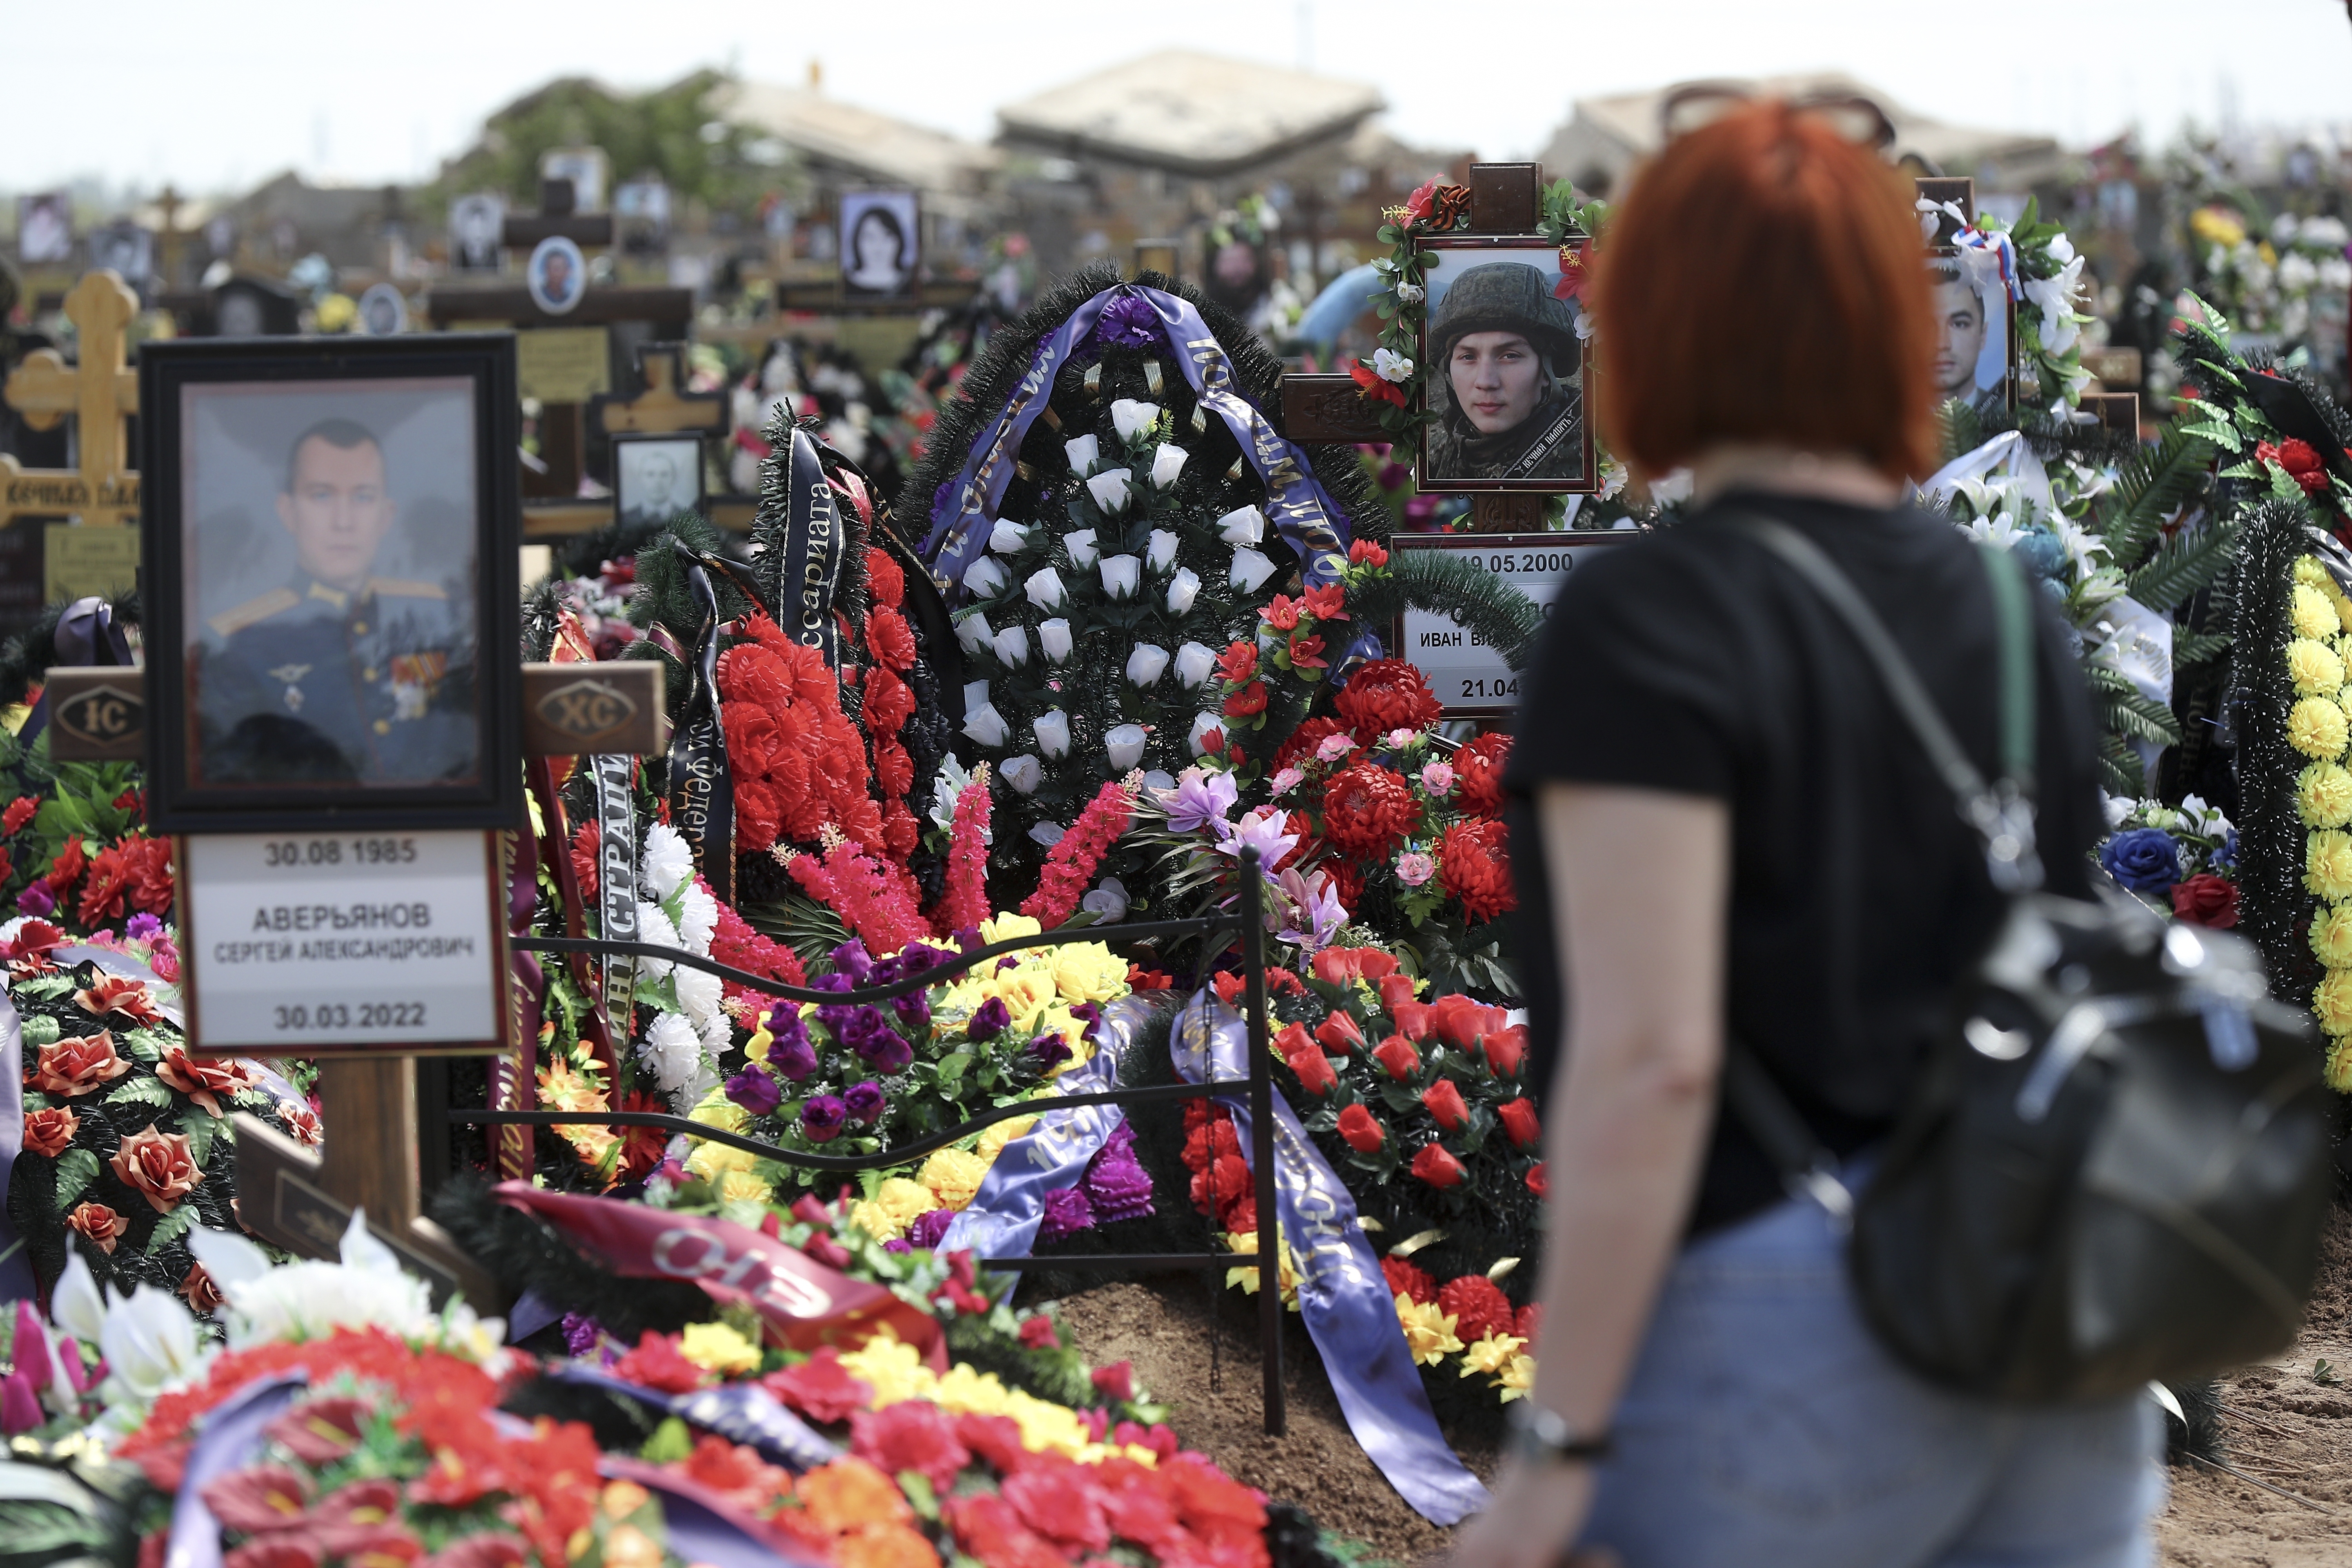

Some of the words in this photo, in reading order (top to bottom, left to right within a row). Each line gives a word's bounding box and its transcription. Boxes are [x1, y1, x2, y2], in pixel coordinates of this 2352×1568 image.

[1522, 443, 1547, 469] ВЕЧНАЯ
[1544, 418, 1572, 445] ПАМЯТЬ
[802, 483, 833, 650] ссариата
[1420, 632, 1462, 647] ИВАН
[1461, 679, 1519, 697] 21.04
[677, 756, 723, 873] Федера
[252, 903, 431, 932] АВЕРЬЯНОВ
[601, 753, 635, 1064] ИНИСТРАЦИ
[214, 937, 293, 963] СЕРГЕЙ
[298, 936, 475, 960] АЛЕКСАНДРОВИЧ
[274, 1002, 426, 1030] 30.03.2022
